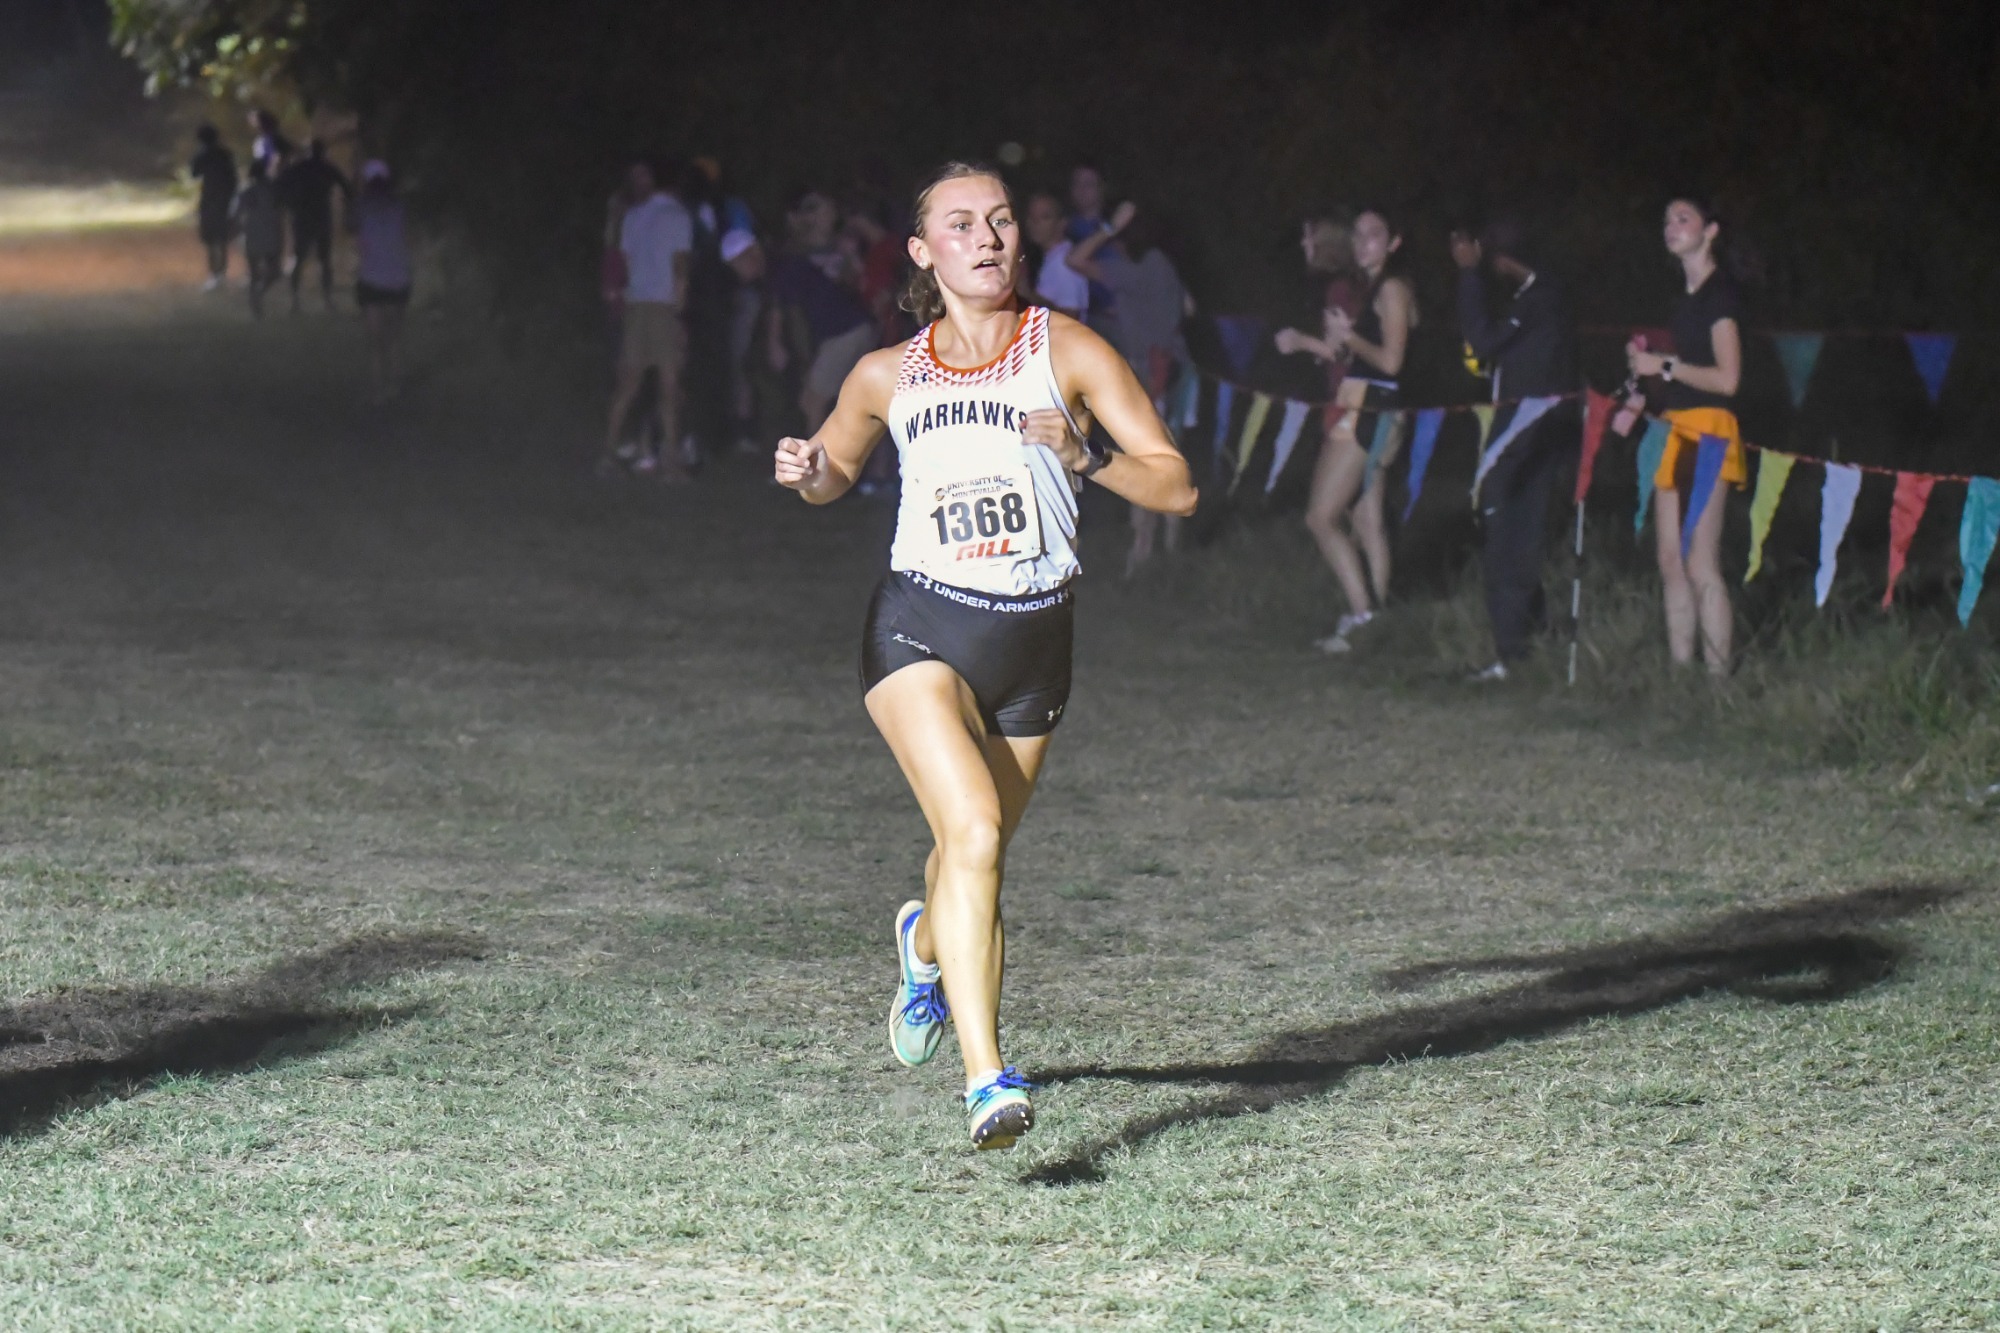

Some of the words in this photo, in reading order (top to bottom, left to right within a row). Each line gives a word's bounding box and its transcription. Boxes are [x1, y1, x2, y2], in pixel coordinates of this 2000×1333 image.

[906, 400, 1028, 444] WARHAWKS
[930, 492, 1027, 545] 1368
[956, 539, 1010, 561] GILL
[934, 583, 991, 612] UNDER
[992, 596, 1056, 613] ARMOUR
